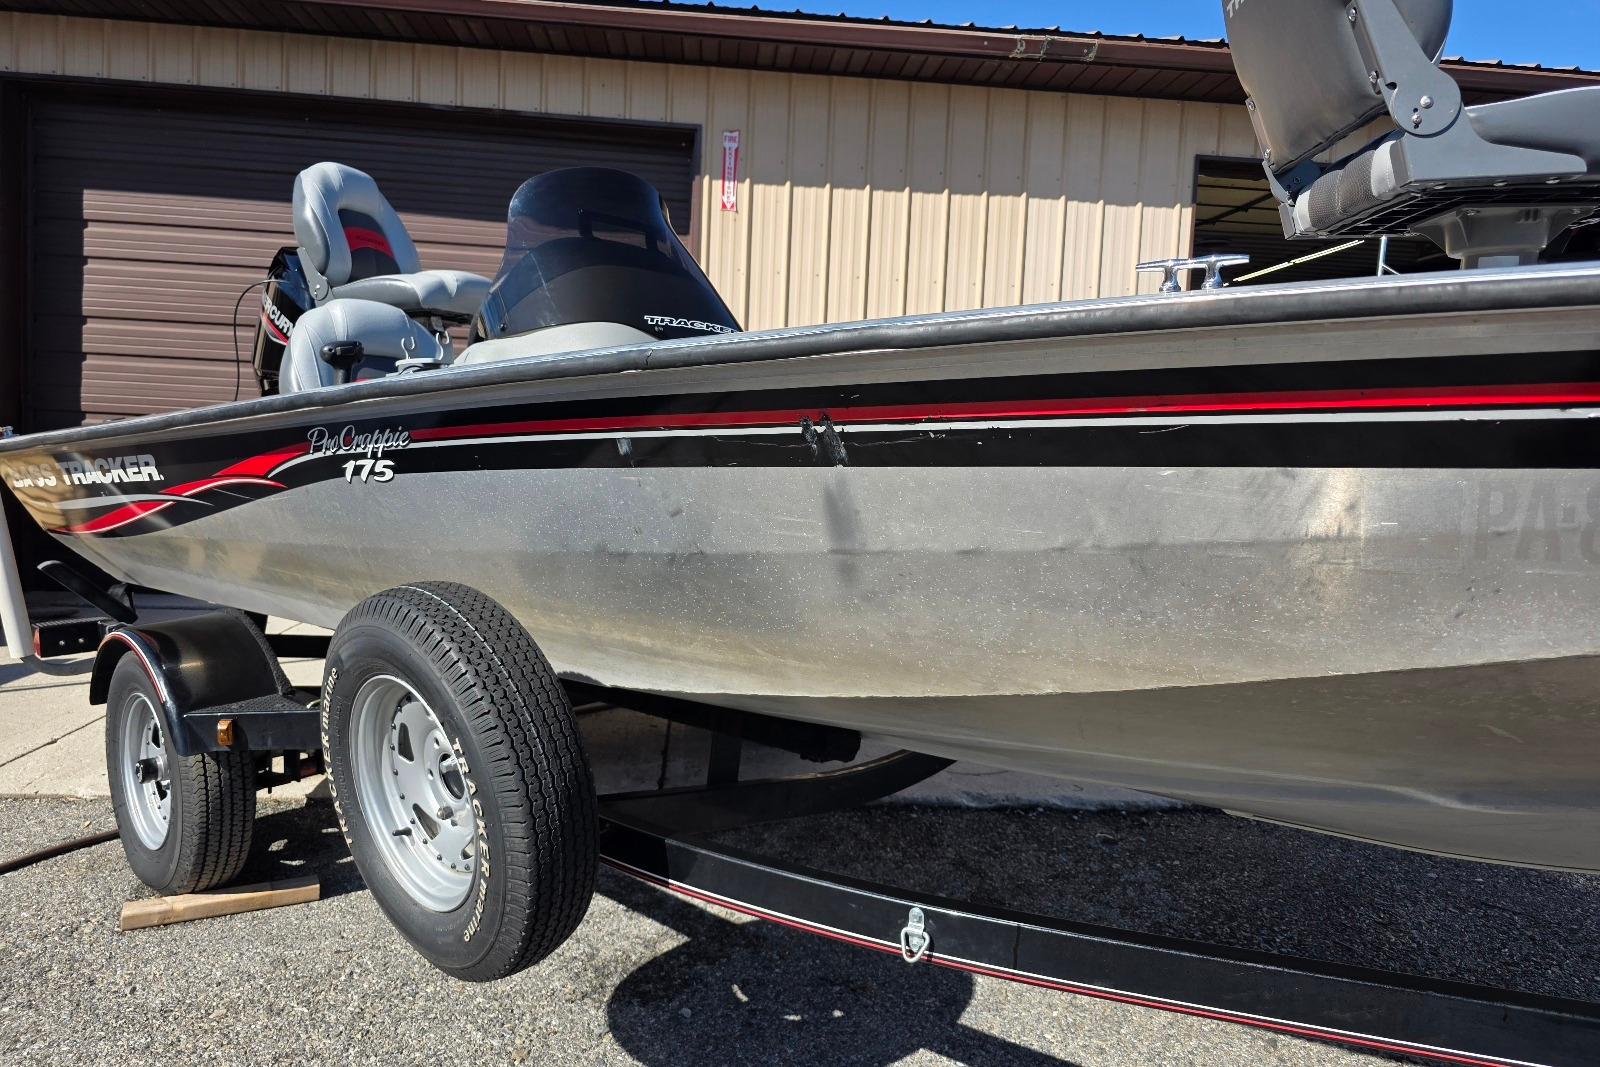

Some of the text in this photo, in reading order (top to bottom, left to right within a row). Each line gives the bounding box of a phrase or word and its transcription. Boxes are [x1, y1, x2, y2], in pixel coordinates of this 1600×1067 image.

[342, 459, 395, 483] 175
[321, 667, 339, 731] marine
[321, 731, 353, 847] TRACKER
[452, 737, 491, 942] TRACKER marine
